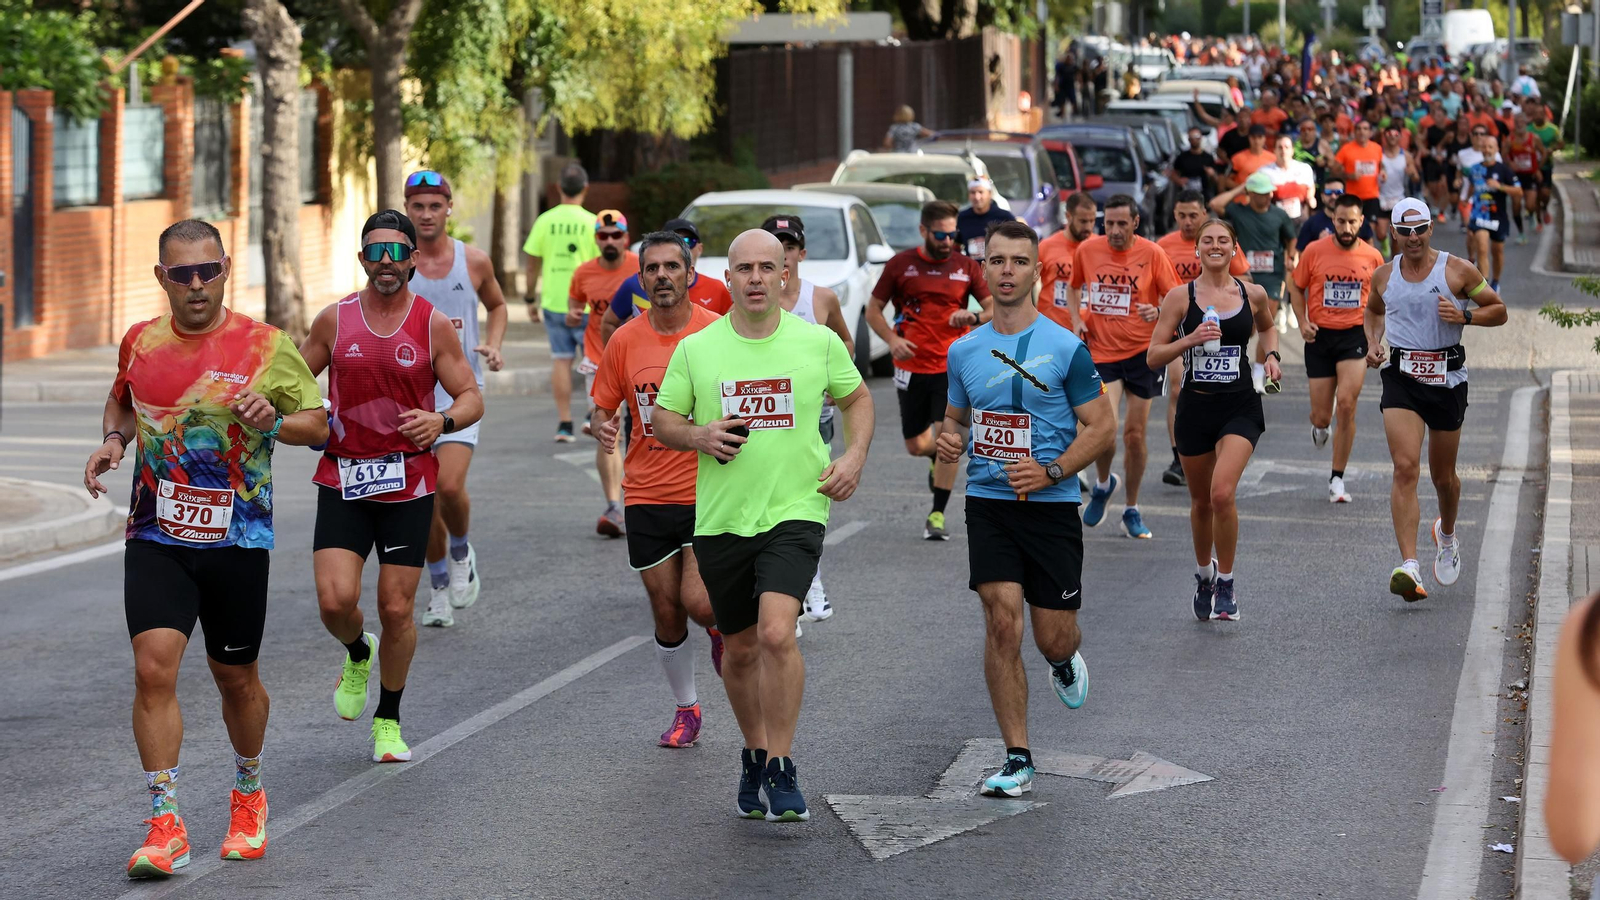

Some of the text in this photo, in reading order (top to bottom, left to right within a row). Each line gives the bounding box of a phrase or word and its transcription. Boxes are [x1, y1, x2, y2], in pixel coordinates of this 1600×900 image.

[550, 223, 586, 235] STAFF
[1099, 294, 1120, 305] 427
[1333, 290, 1352, 300] 837
[1205, 358, 1230, 371] 675
[1411, 362, 1435, 374] 252
[738, 396, 776, 414] 470
[984, 427, 1014, 446] 420
[355, 464, 387, 482] 619
[172, 503, 213, 525] 370
